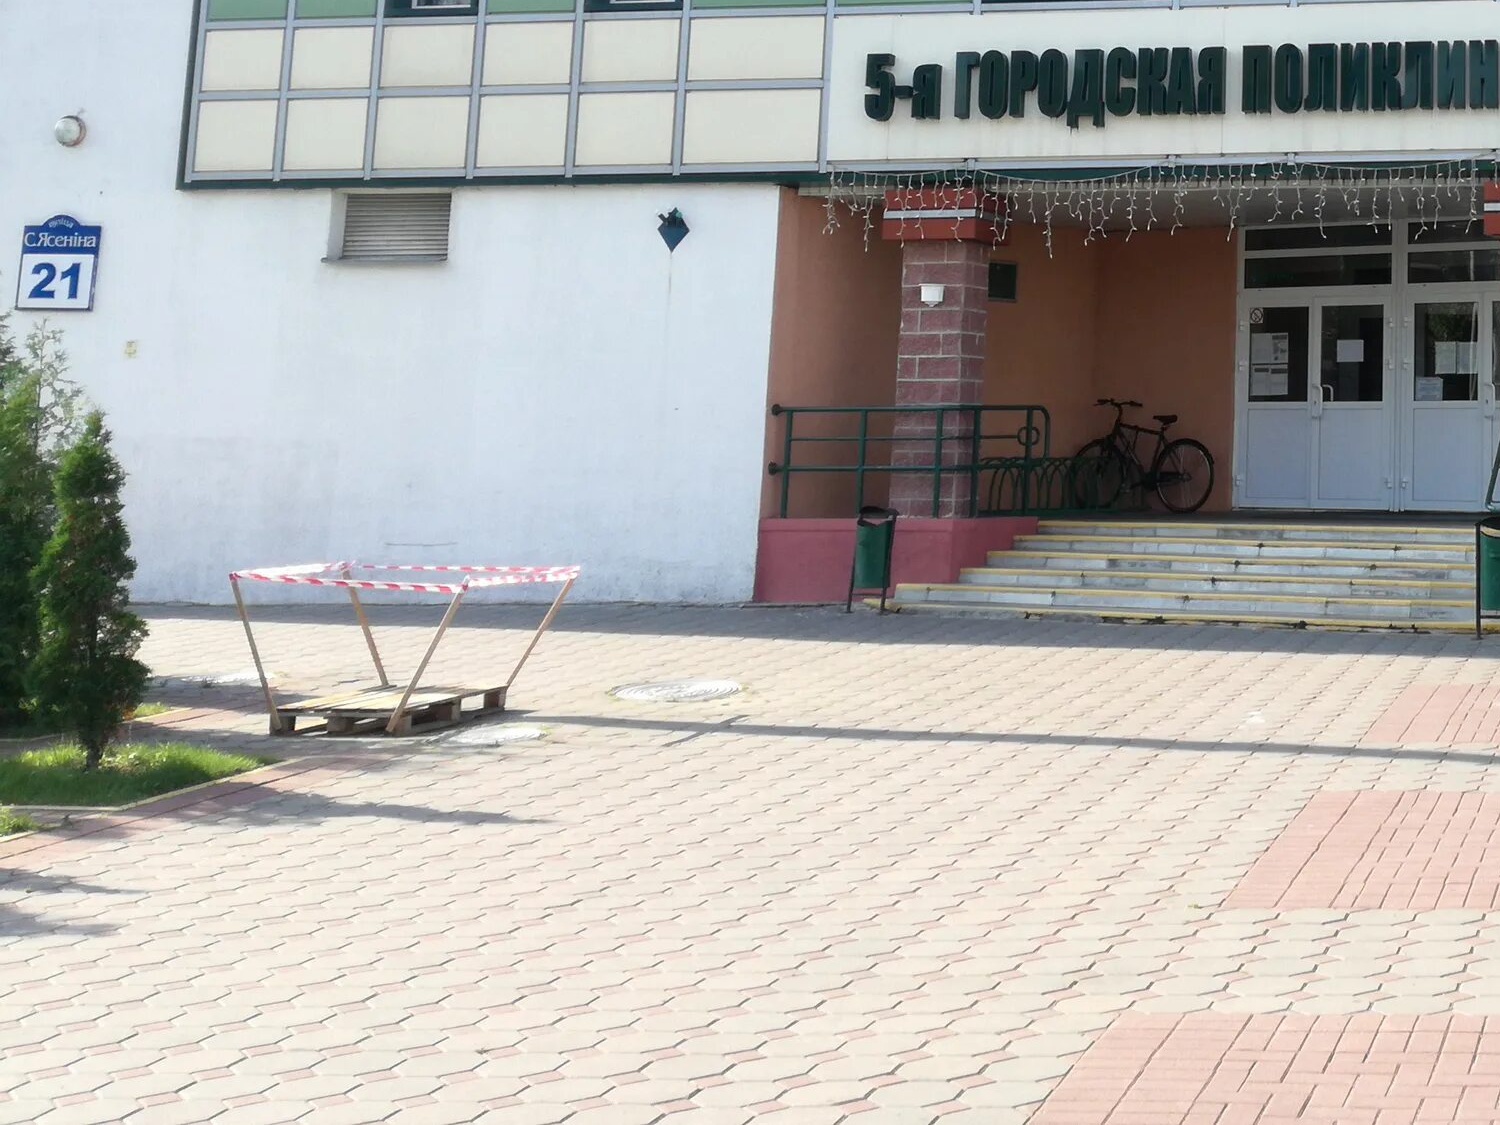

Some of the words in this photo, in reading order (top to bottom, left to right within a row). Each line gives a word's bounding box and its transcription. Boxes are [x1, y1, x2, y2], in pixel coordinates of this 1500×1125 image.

[865, 53, 943, 122] 5-я
[954, 46, 1227, 129] ГОРОДСКАЯ
[27, 262, 82, 300] 21
